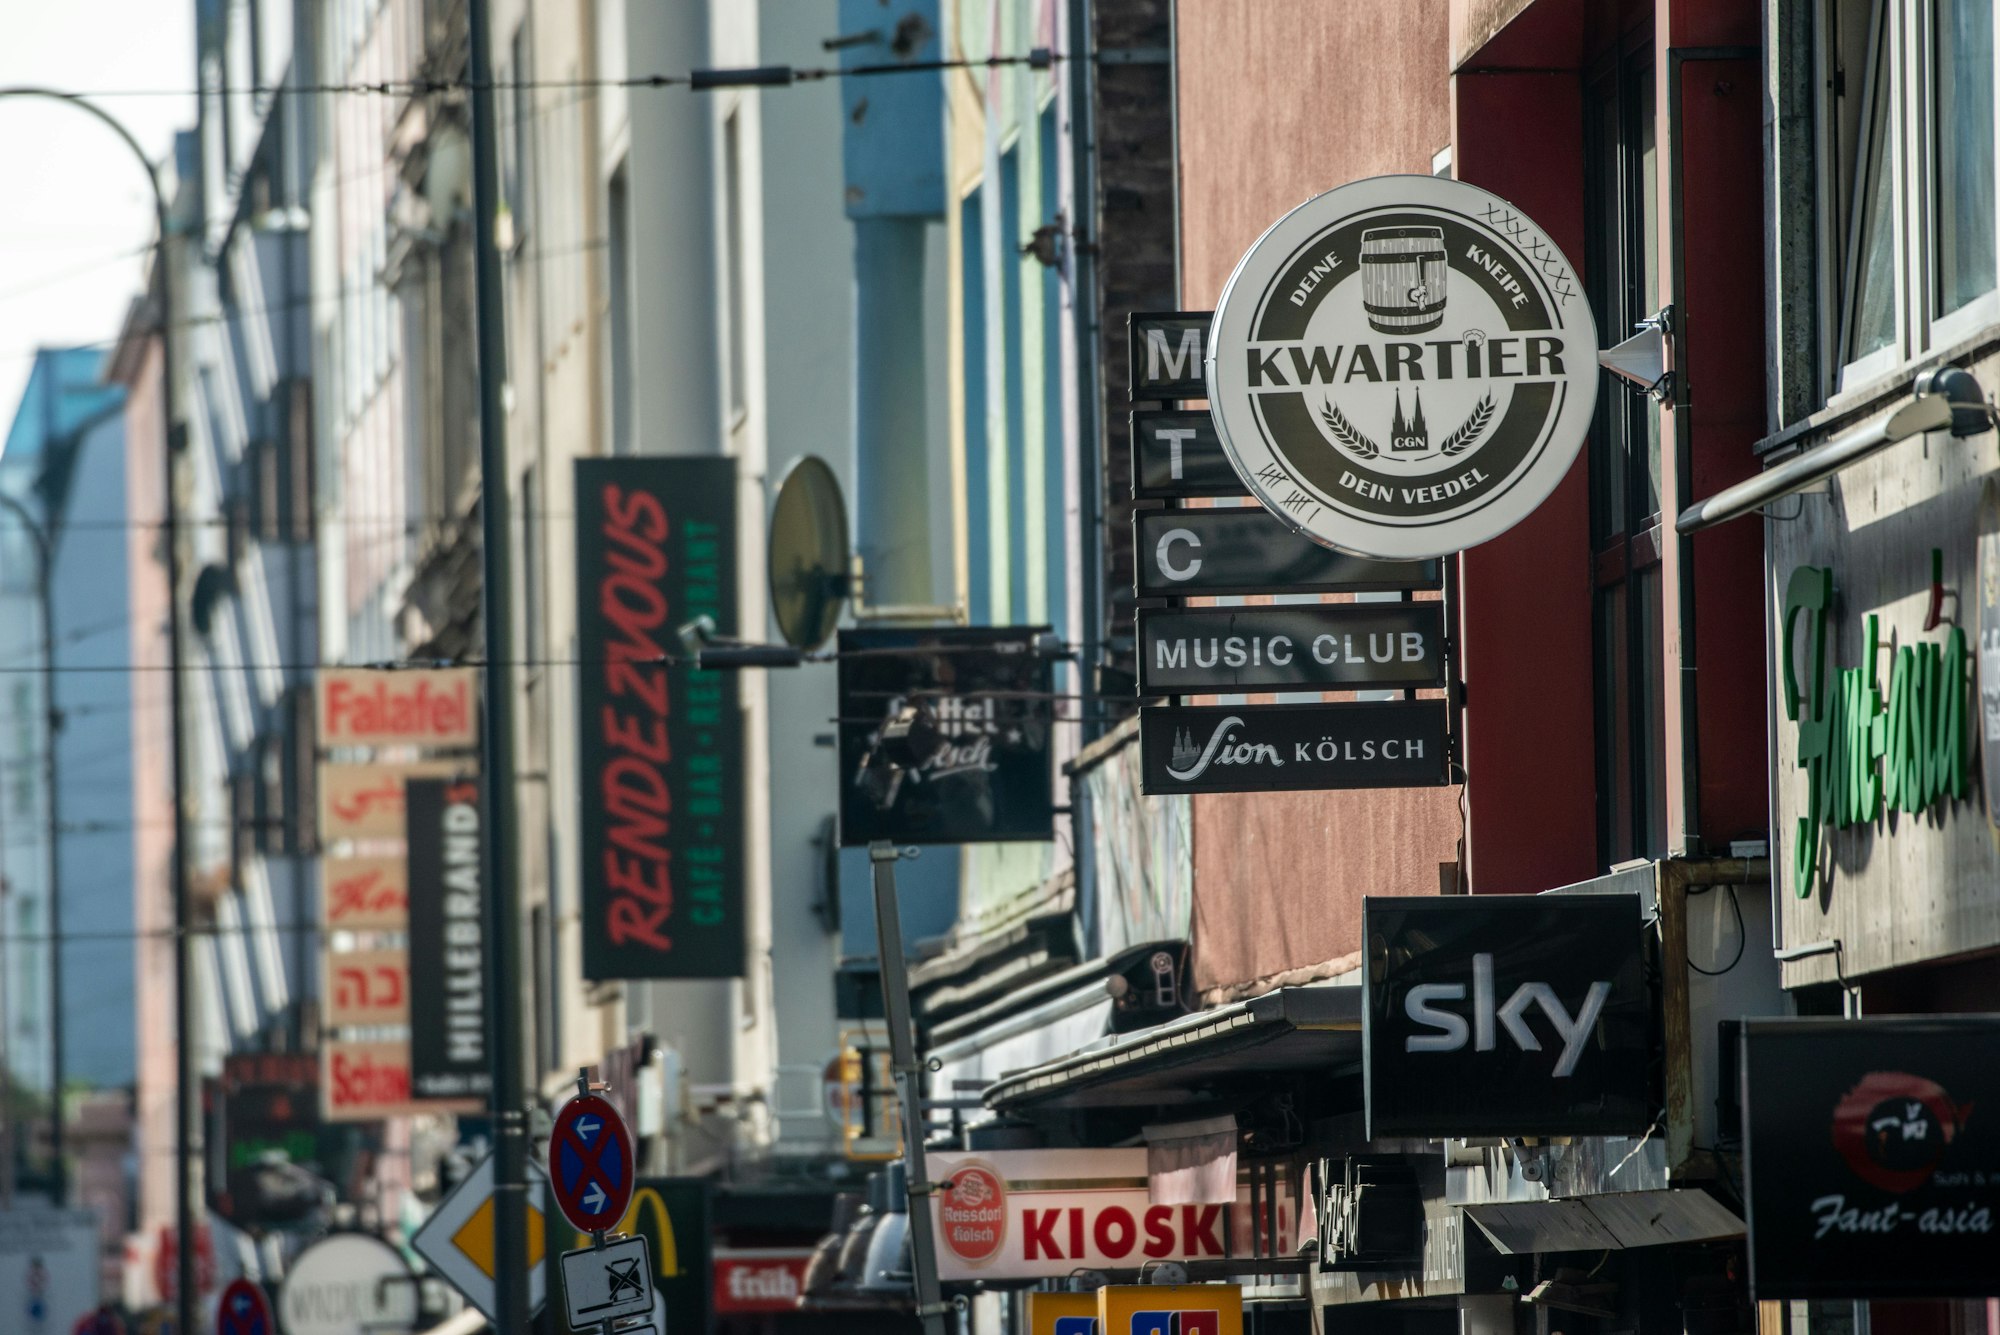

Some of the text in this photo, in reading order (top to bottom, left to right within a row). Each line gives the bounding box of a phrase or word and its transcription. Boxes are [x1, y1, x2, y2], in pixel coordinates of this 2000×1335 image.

[1290, 251, 1342, 307] DEINE
[1466, 244, 1530, 309] KNEIPE
[1146, 328, 1202, 381] M
[1247, 332, 1566, 387] KWARTIER
[1155, 428, 1196, 480] T
[1394, 436, 1425, 448] CGN
[1339, 467, 1489, 504] DEIN VEEDEL
[1156, 528, 1202, 582] C
[1156, 632, 1425, 669] MUSIC CLUB
[324, 677, 468, 737] Falafel
[601, 483, 672, 952] RENDEZVOUS
[1295, 736, 1425, 762] KÖLSCH
[686, 753, 723, 816] BAR
[1405, 953, 1613, 1077] sky
[1022, 1204, 1225, 1261] KIOSK
[1810, 1193, 1994, 1241] Fant-asia
